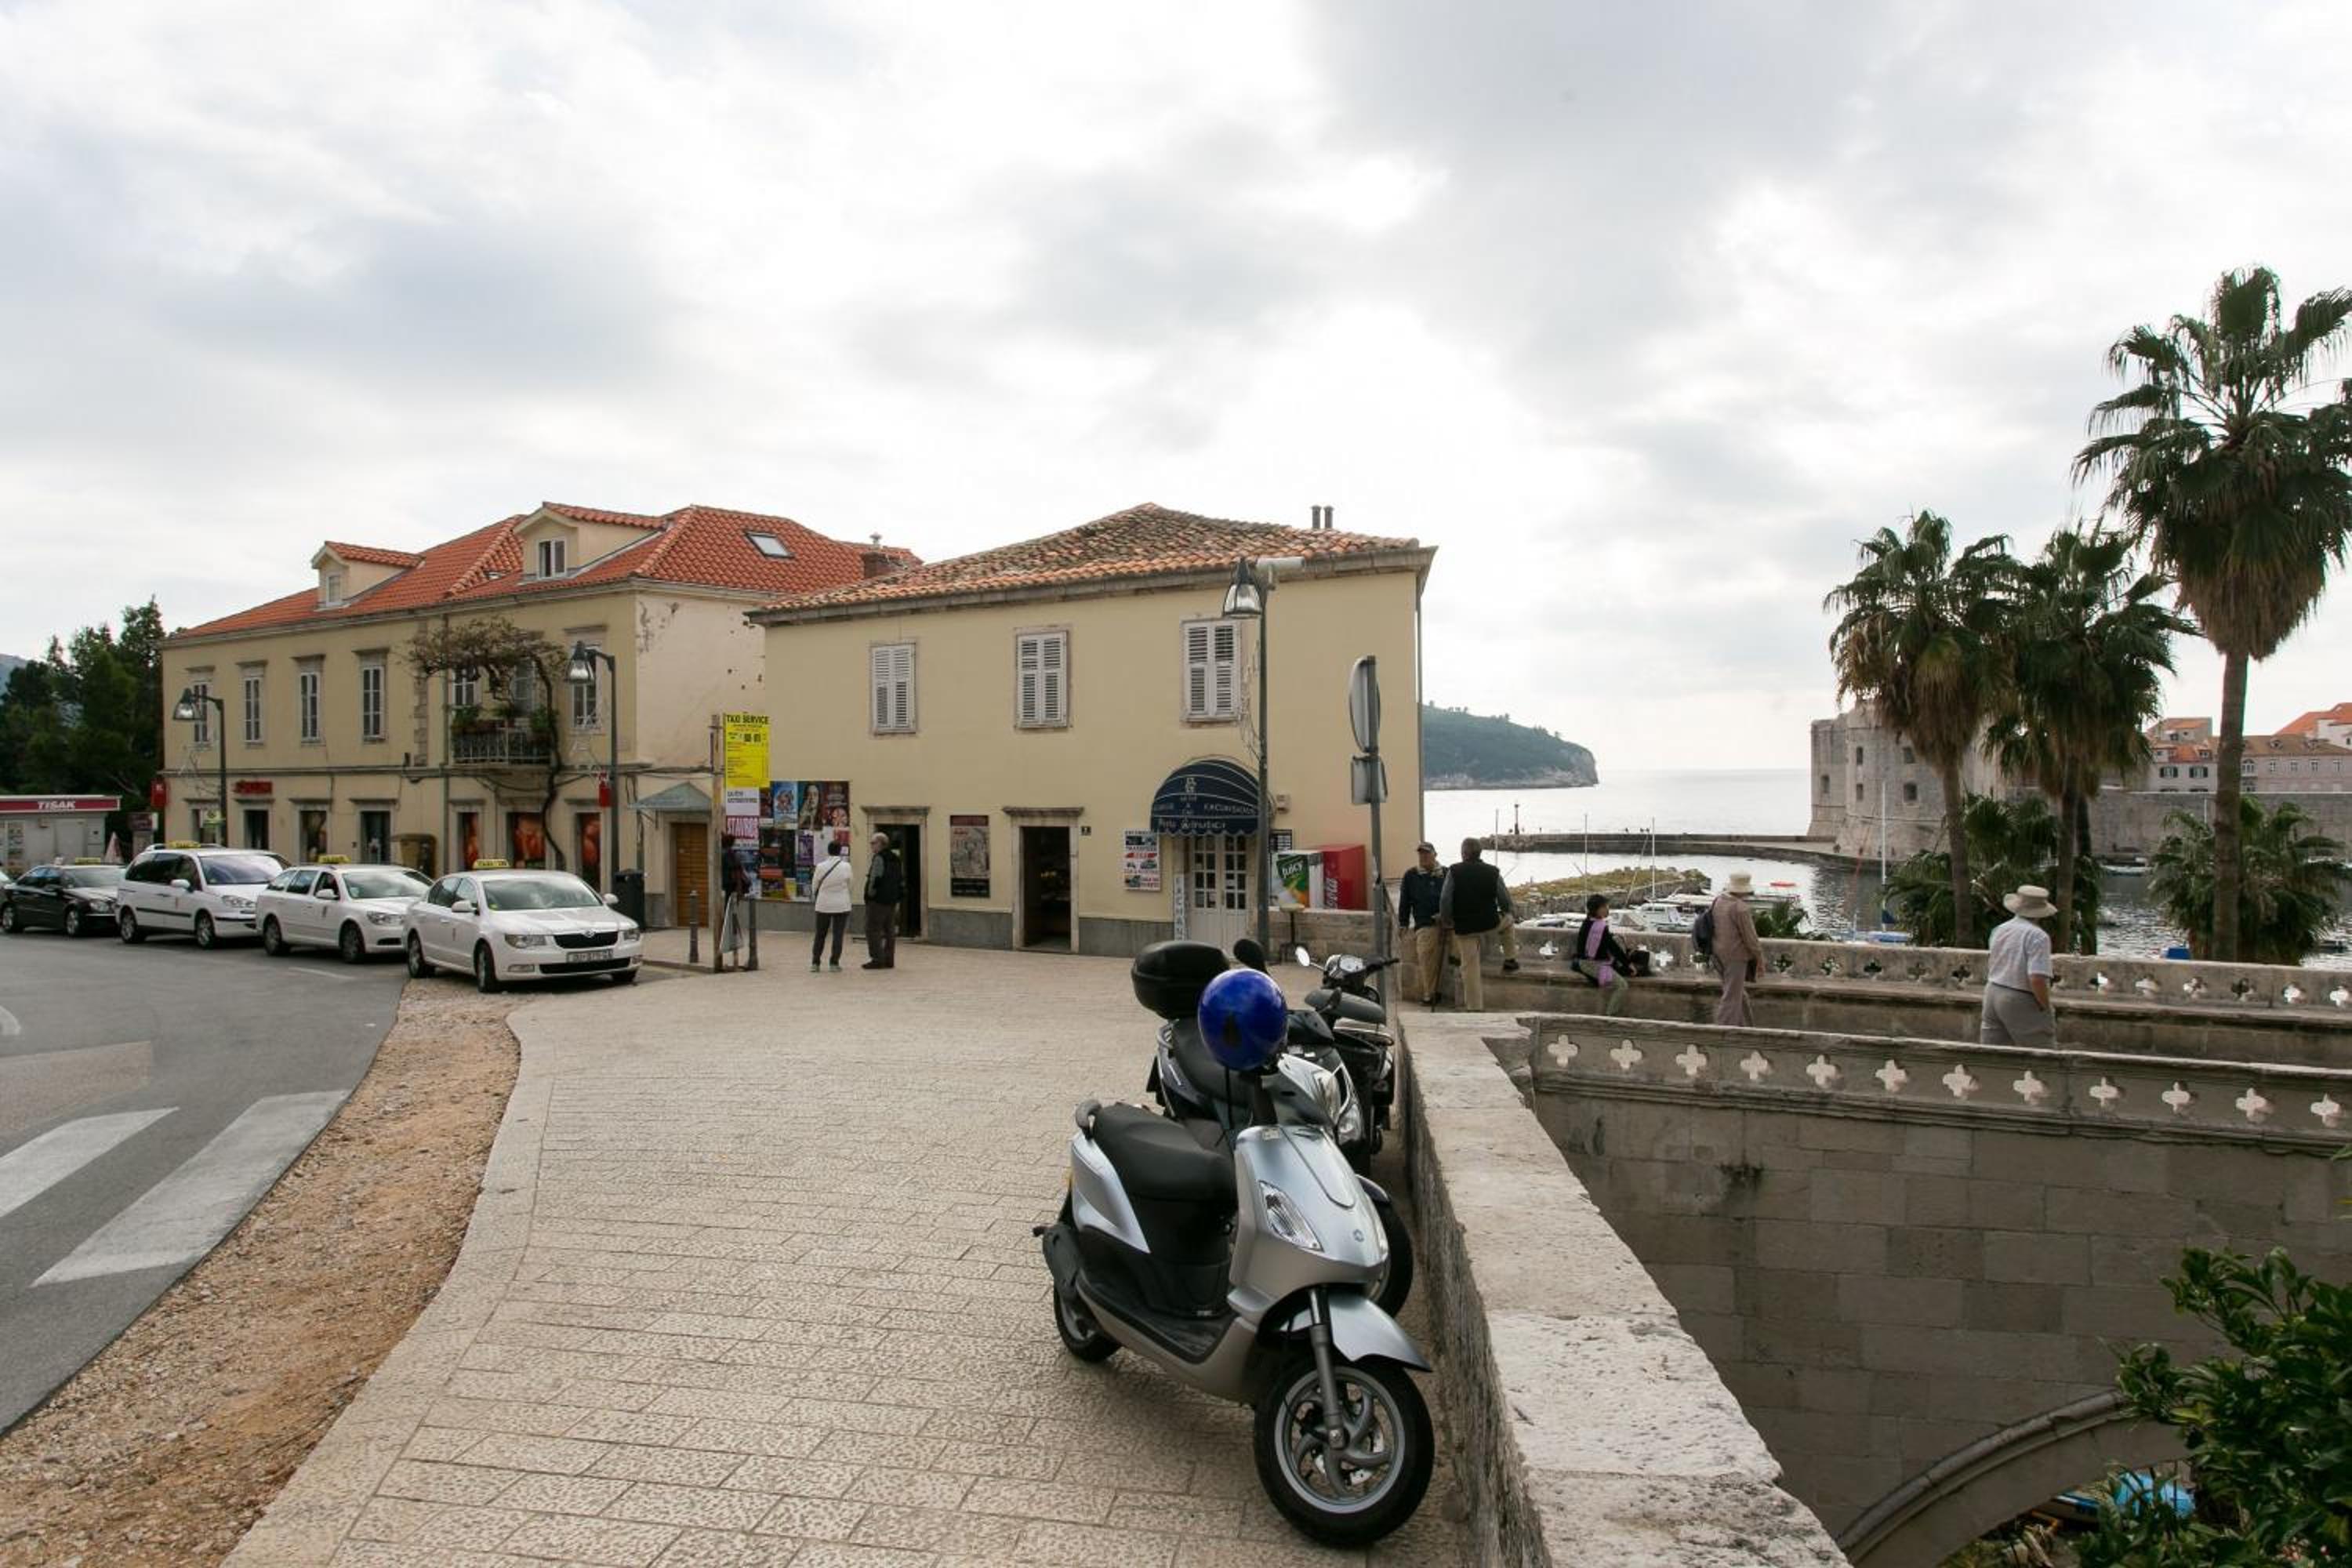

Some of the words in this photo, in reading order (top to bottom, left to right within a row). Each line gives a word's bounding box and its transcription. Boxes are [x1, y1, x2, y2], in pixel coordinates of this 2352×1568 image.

[726, 714, 741, 724] TAXI
[742, 714, 770, 725] SERVICE
[37, 800, 76, 810] TISAK
